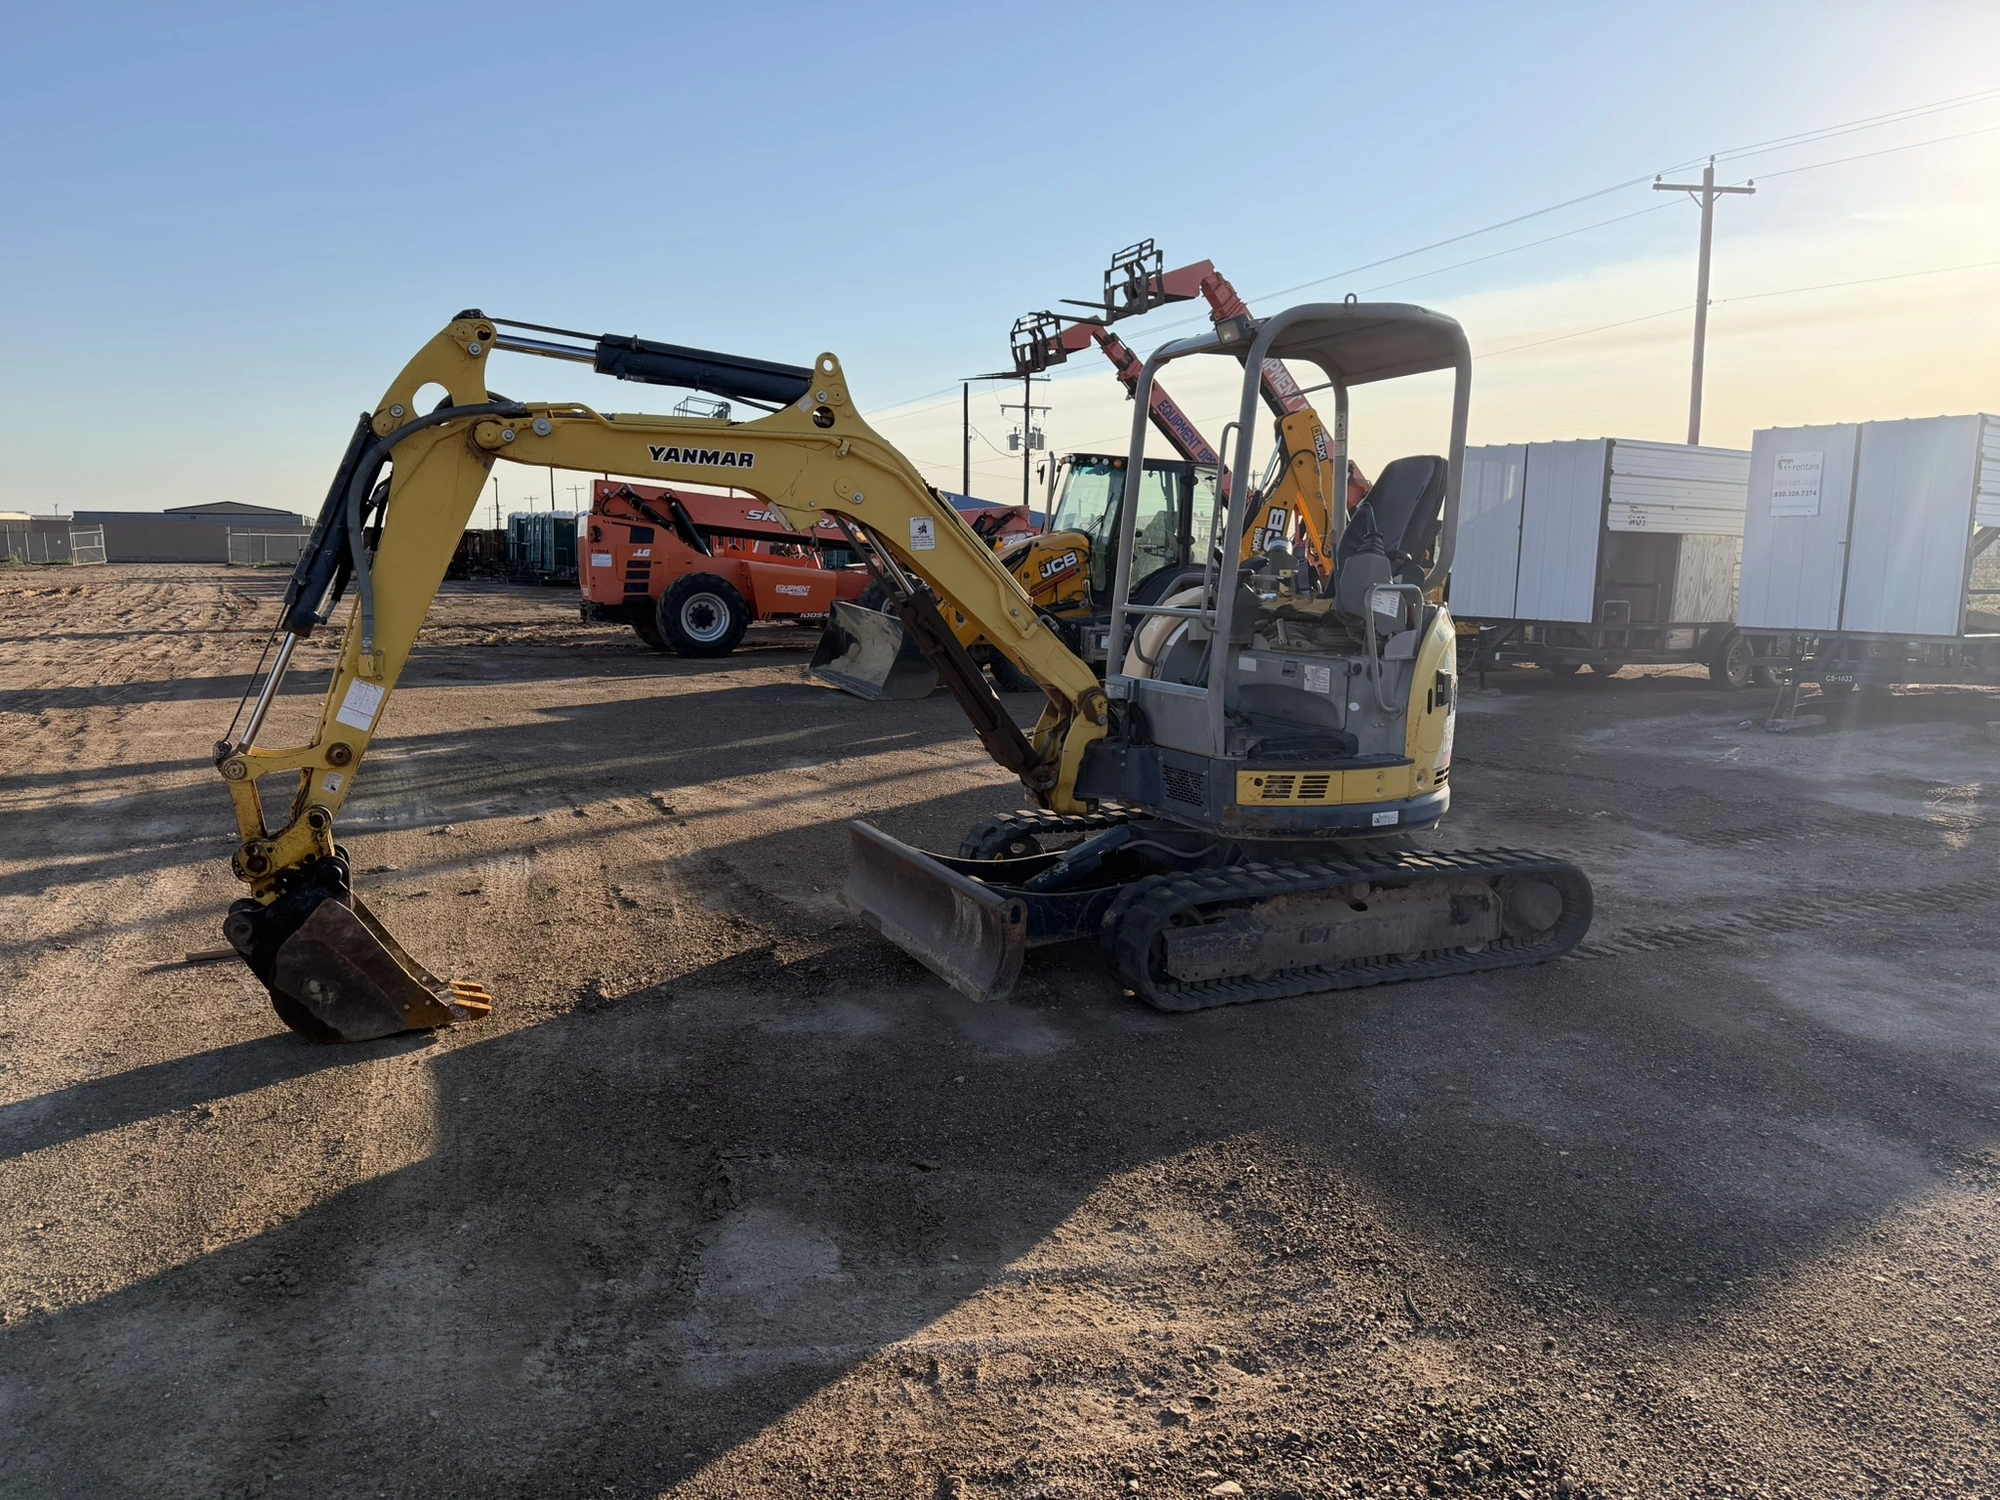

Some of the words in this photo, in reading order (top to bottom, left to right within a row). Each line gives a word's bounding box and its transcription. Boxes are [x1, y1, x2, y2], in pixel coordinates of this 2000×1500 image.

[1157, 399, 1202, 449] EQUIPMENT
[647, 445, 755, 468] YANMAR
[1793, 462, 1820, 471] rentals
[1041, 551, 1078, 578] JCB
[775, 584, 811, 593] EQUIPMENT
